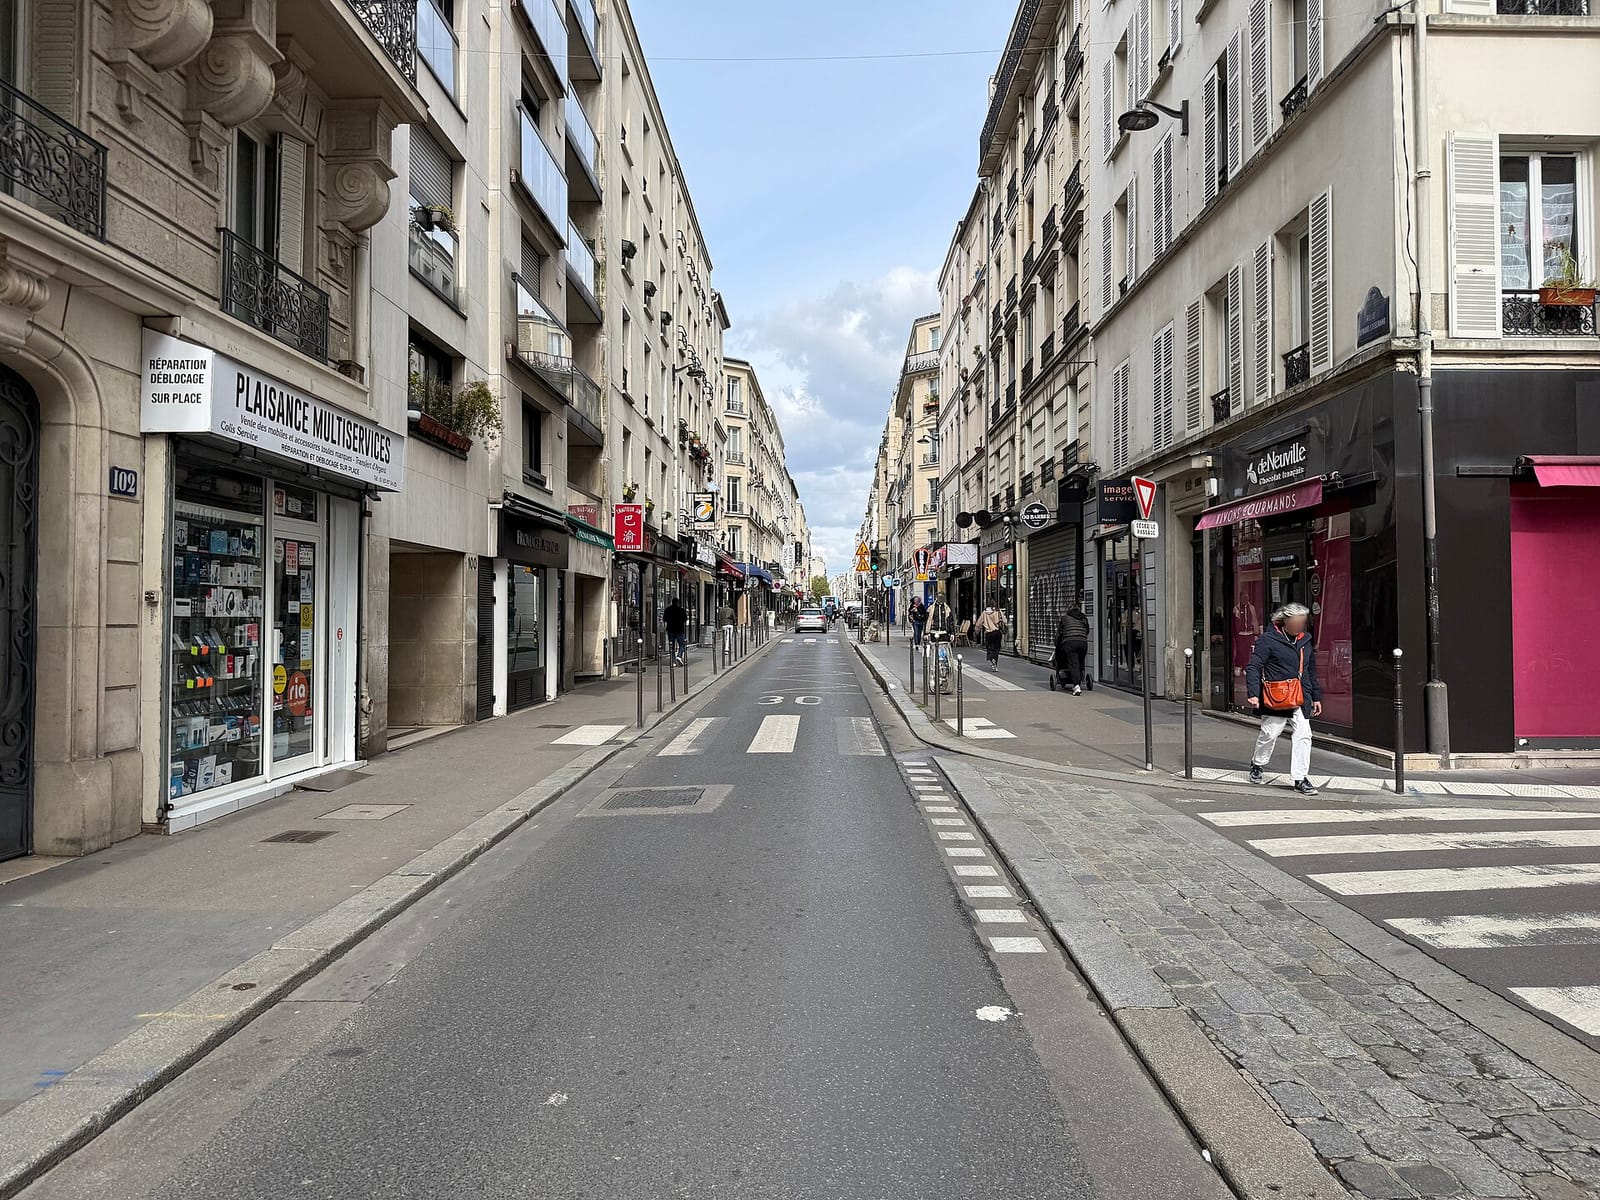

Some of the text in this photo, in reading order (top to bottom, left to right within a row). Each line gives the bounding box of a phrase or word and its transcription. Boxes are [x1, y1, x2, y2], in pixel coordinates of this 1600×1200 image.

[149, 357, 207, 370] RÉPARATION
[150, 371, 205, 384] DÉBLOCAGE
[151, 392, 202, 404] SUR PLACE
[235, 372, 391, 465] PLAISANCE MULTISERVICES
[220, 420, 259, 442] Colis Service
[240, 414, 257, 429] Vente
[257, 421, 267, 433] des
[268, 427, 288, 440] mobiles
[288, 434, 294, 443] et
[294, 436, 321, 452] accessoires
[113, 469, 136, 493] 102
[1259, 471, 1282, 486] Chocolat
[1103, 485, 1133, 496] image
[290, 676, 306, 700] ria
[754, 695, 823, 705] 30
